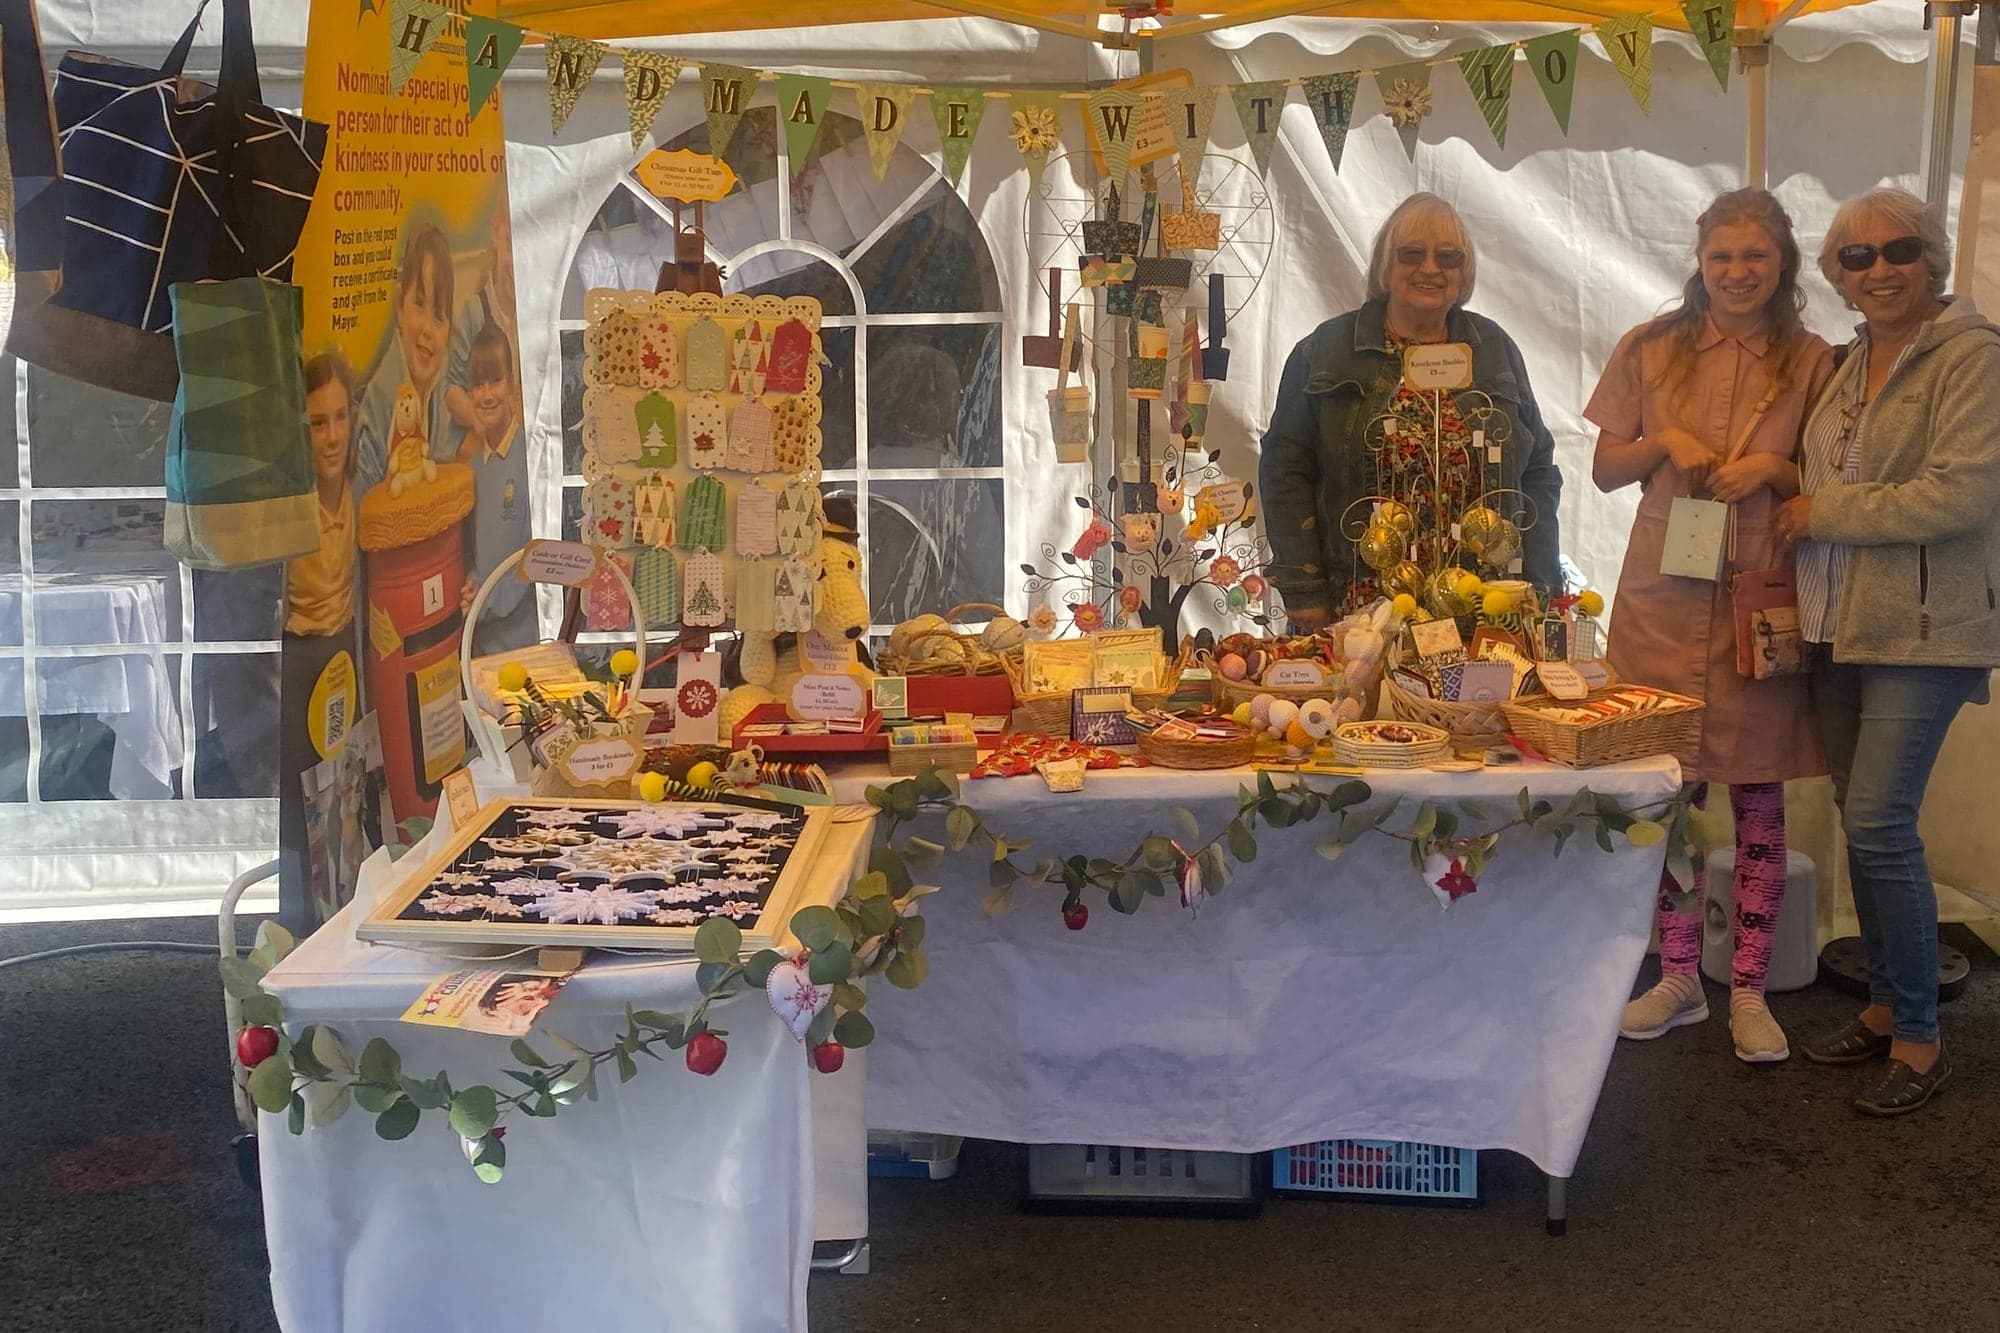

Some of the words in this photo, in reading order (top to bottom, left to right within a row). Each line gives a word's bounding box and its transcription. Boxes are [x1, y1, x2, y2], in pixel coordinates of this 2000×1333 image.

[337, 62, 390, 96] Nominat
[407, 75, 450, 104] special
[453, 82, 499, 111] yog
[336, 109, 381, 139] person
[382, 106, 399, 134] for
[402, 109, 433, 136] their
[433, 114, 452, 137] act
[455, 113, 472, 138] of
[1136, 138, 1149, 150] £3
[335, 143, 389, 172] kindness
[391, 145, 402, 172] in
[404, 152, 434, 178] your
[436, 148, 486, 173] school
[490, 155, 505, 173] or
[651, 162, 687, 173] Christmas
[688, 166, 703, 174] Gift
[334, 183, 404, 216] community.
[334, 229, 355, 246] Post
[355, 229, 362, 244] in
[363, 228, 373, 243] the
[373, 227, 383, 242] red
[383, 226, 398, 244] post
[334, 250, 351, 267] box
[352, 250, 365, 265] and
[365, 252, 376, 266] you
[376, 245, 392, 261] could
[333, 270, 362, 288] receive
[368, 266, 399, 283] certificate
[332, 293, 350, 309] and
[351, 290, 363, 311] gift
[363, 289, 377, 304] from
[559, 552, 574, 561] Gift
[1292, 670, 1310, 681] Toys
[569, 755, 601, 765] Handmade
[602, 751, 635, 761] Bookmarks
